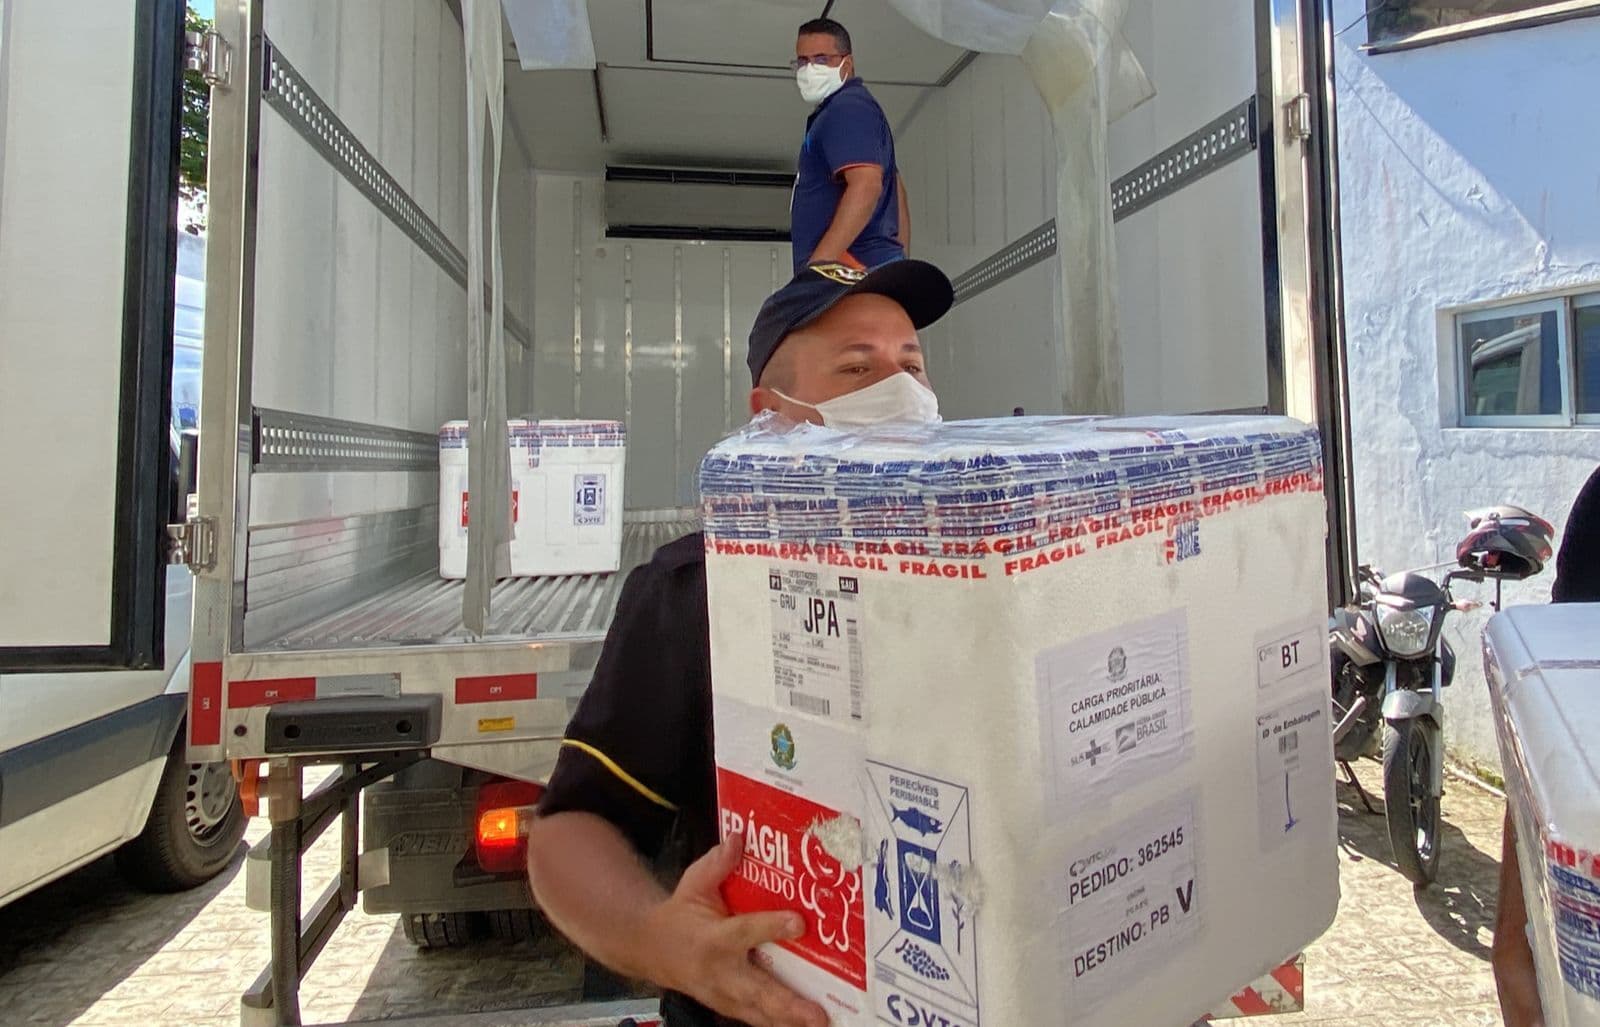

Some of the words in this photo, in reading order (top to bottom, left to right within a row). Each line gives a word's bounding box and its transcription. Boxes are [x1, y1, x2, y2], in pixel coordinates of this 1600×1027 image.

[1202, 486, 1261, 509] FRÁGIL
[1004, 543, 1086, 577] FRÁGIL
[1096, 520, 1164, 550] FRÁGIL
[899, 559, 988, 580] FRÁGIL
[804, 596, 840, 638] JPA
[1281, 640, 1300, 669] BT
[1069, 700, 1129, 734] CALAMIDADE
[1130, 686, 1167, 711] PÚBLICA
[1071, 693, 1105, 714] CARGA
[1136, 718, 1168, 741] BRASIL
[1069, 857, 1134, 905] PEDIDO:
[1138, 827, 1185, 867] 362545
[1074, 921, 1148, 978] DESTINO:
[1150, 904, 1171, 932] PB
[1175, 878, 1194, 914] V
